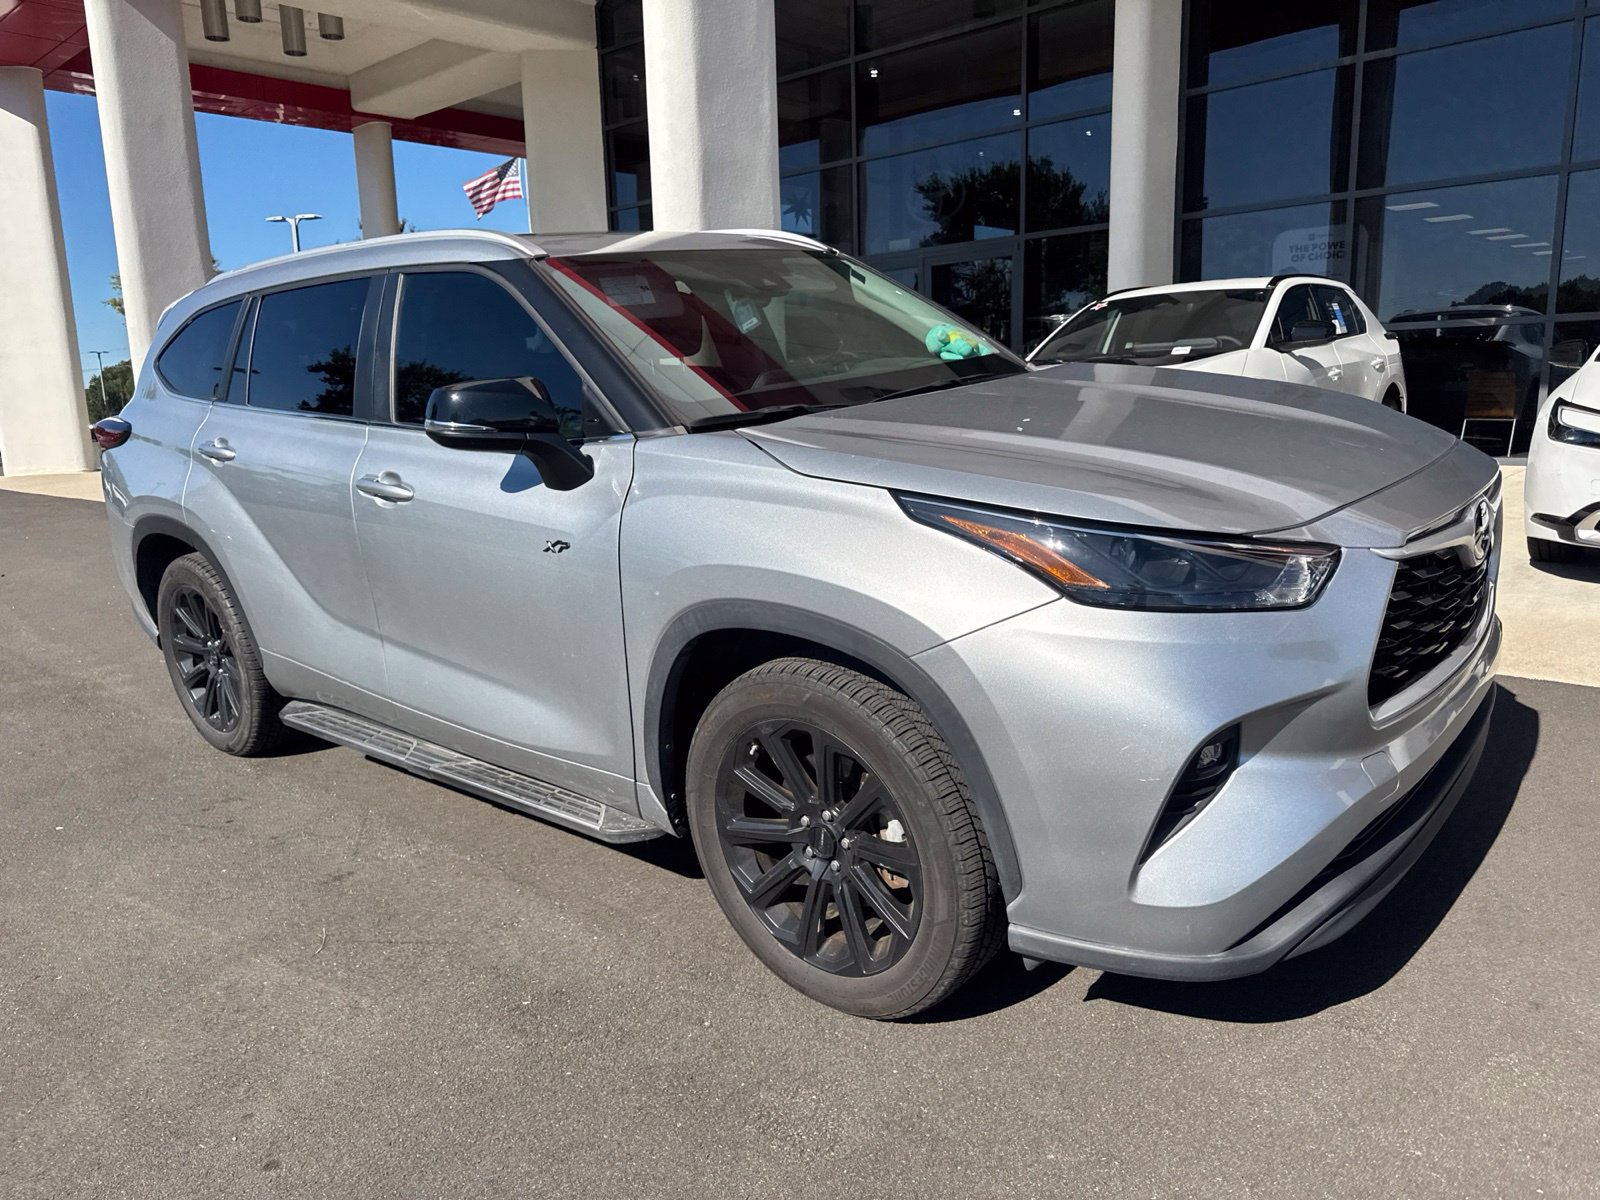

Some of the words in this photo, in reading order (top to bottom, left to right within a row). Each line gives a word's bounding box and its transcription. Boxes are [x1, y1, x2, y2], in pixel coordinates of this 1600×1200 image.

[1289, 244, 1310, 253] THE
[1311, 240, 1345, 251] POWE
[1291, 253, 1306, 262] OF
[1307, 250, 1345, 261] CHOIC
